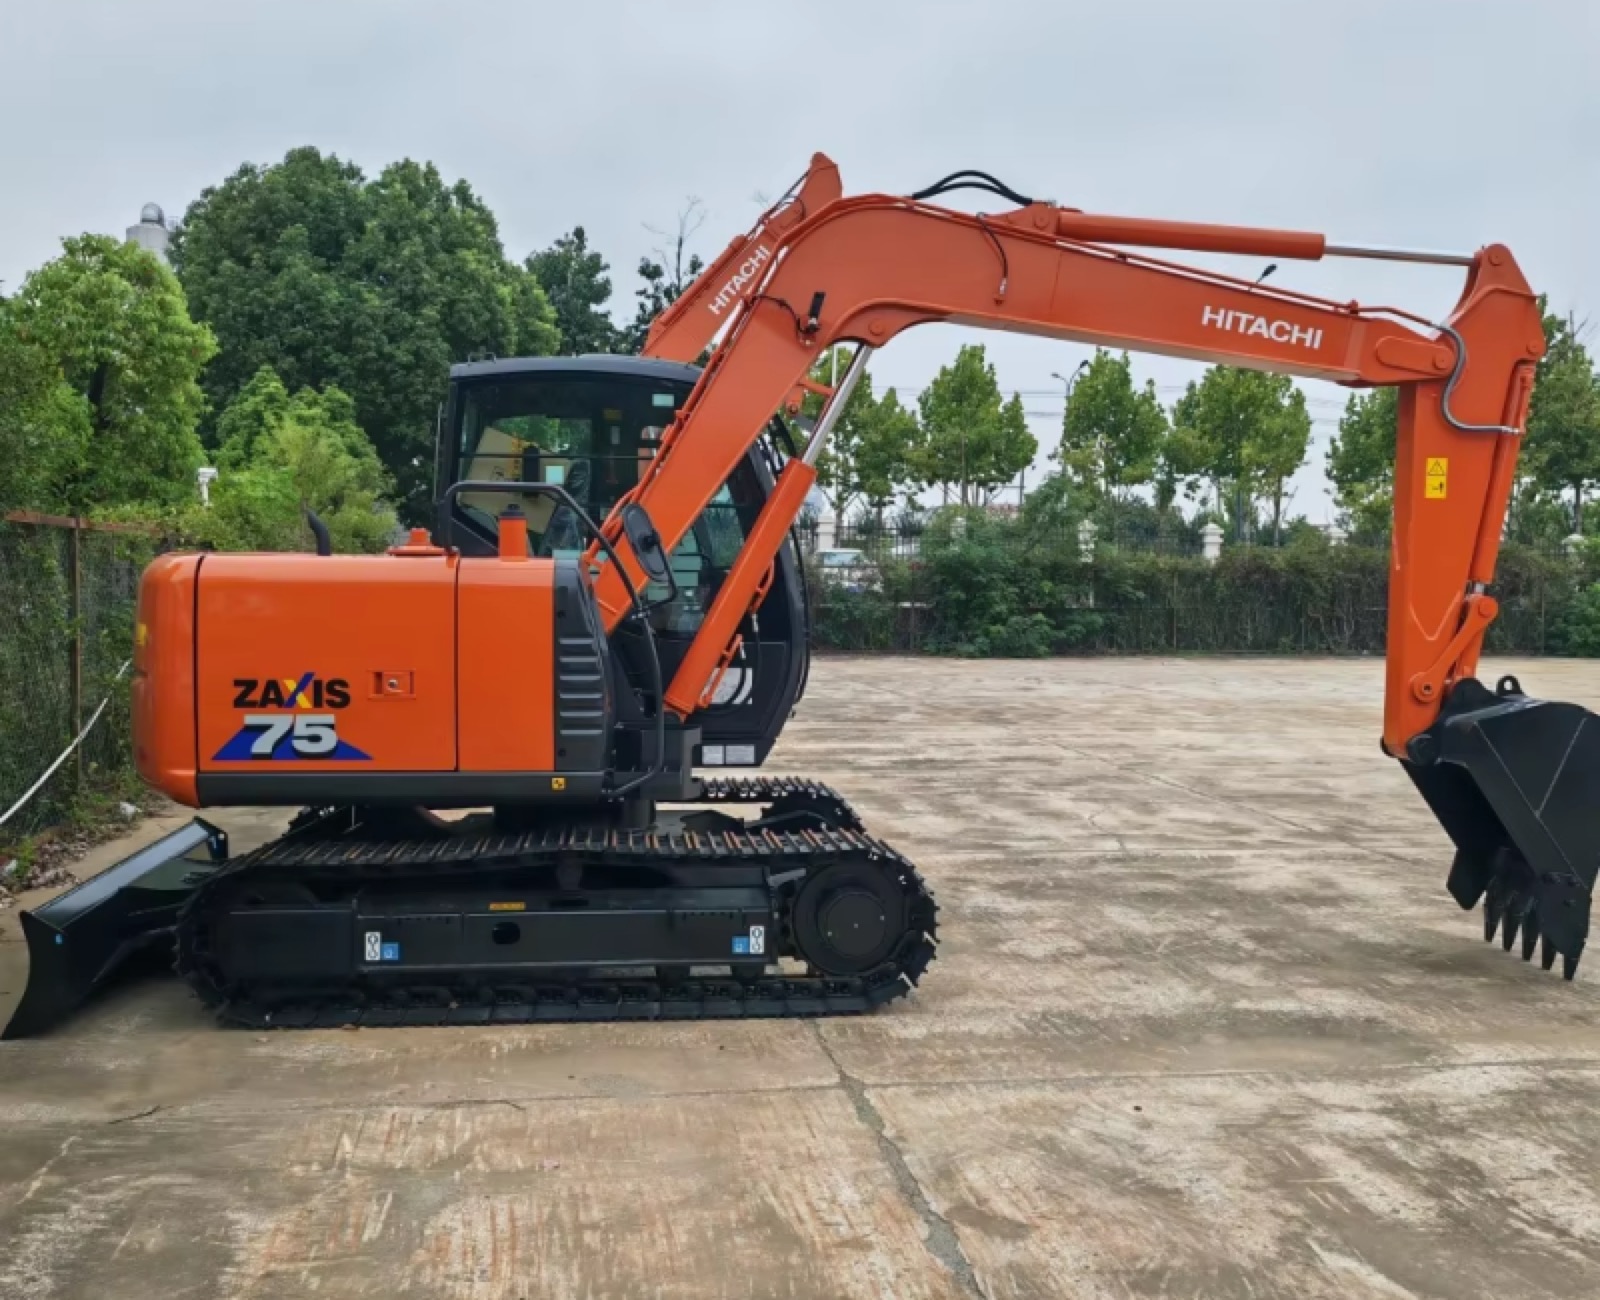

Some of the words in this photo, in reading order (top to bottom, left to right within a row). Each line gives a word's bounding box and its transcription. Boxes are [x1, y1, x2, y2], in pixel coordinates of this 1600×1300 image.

[708, 245, 771, 315] HITACHI
[1201, 305, 1323, 350] HITACHI
[233, 672, 350, 709] ZAXIS
[244, 713, 338, 759] 75
